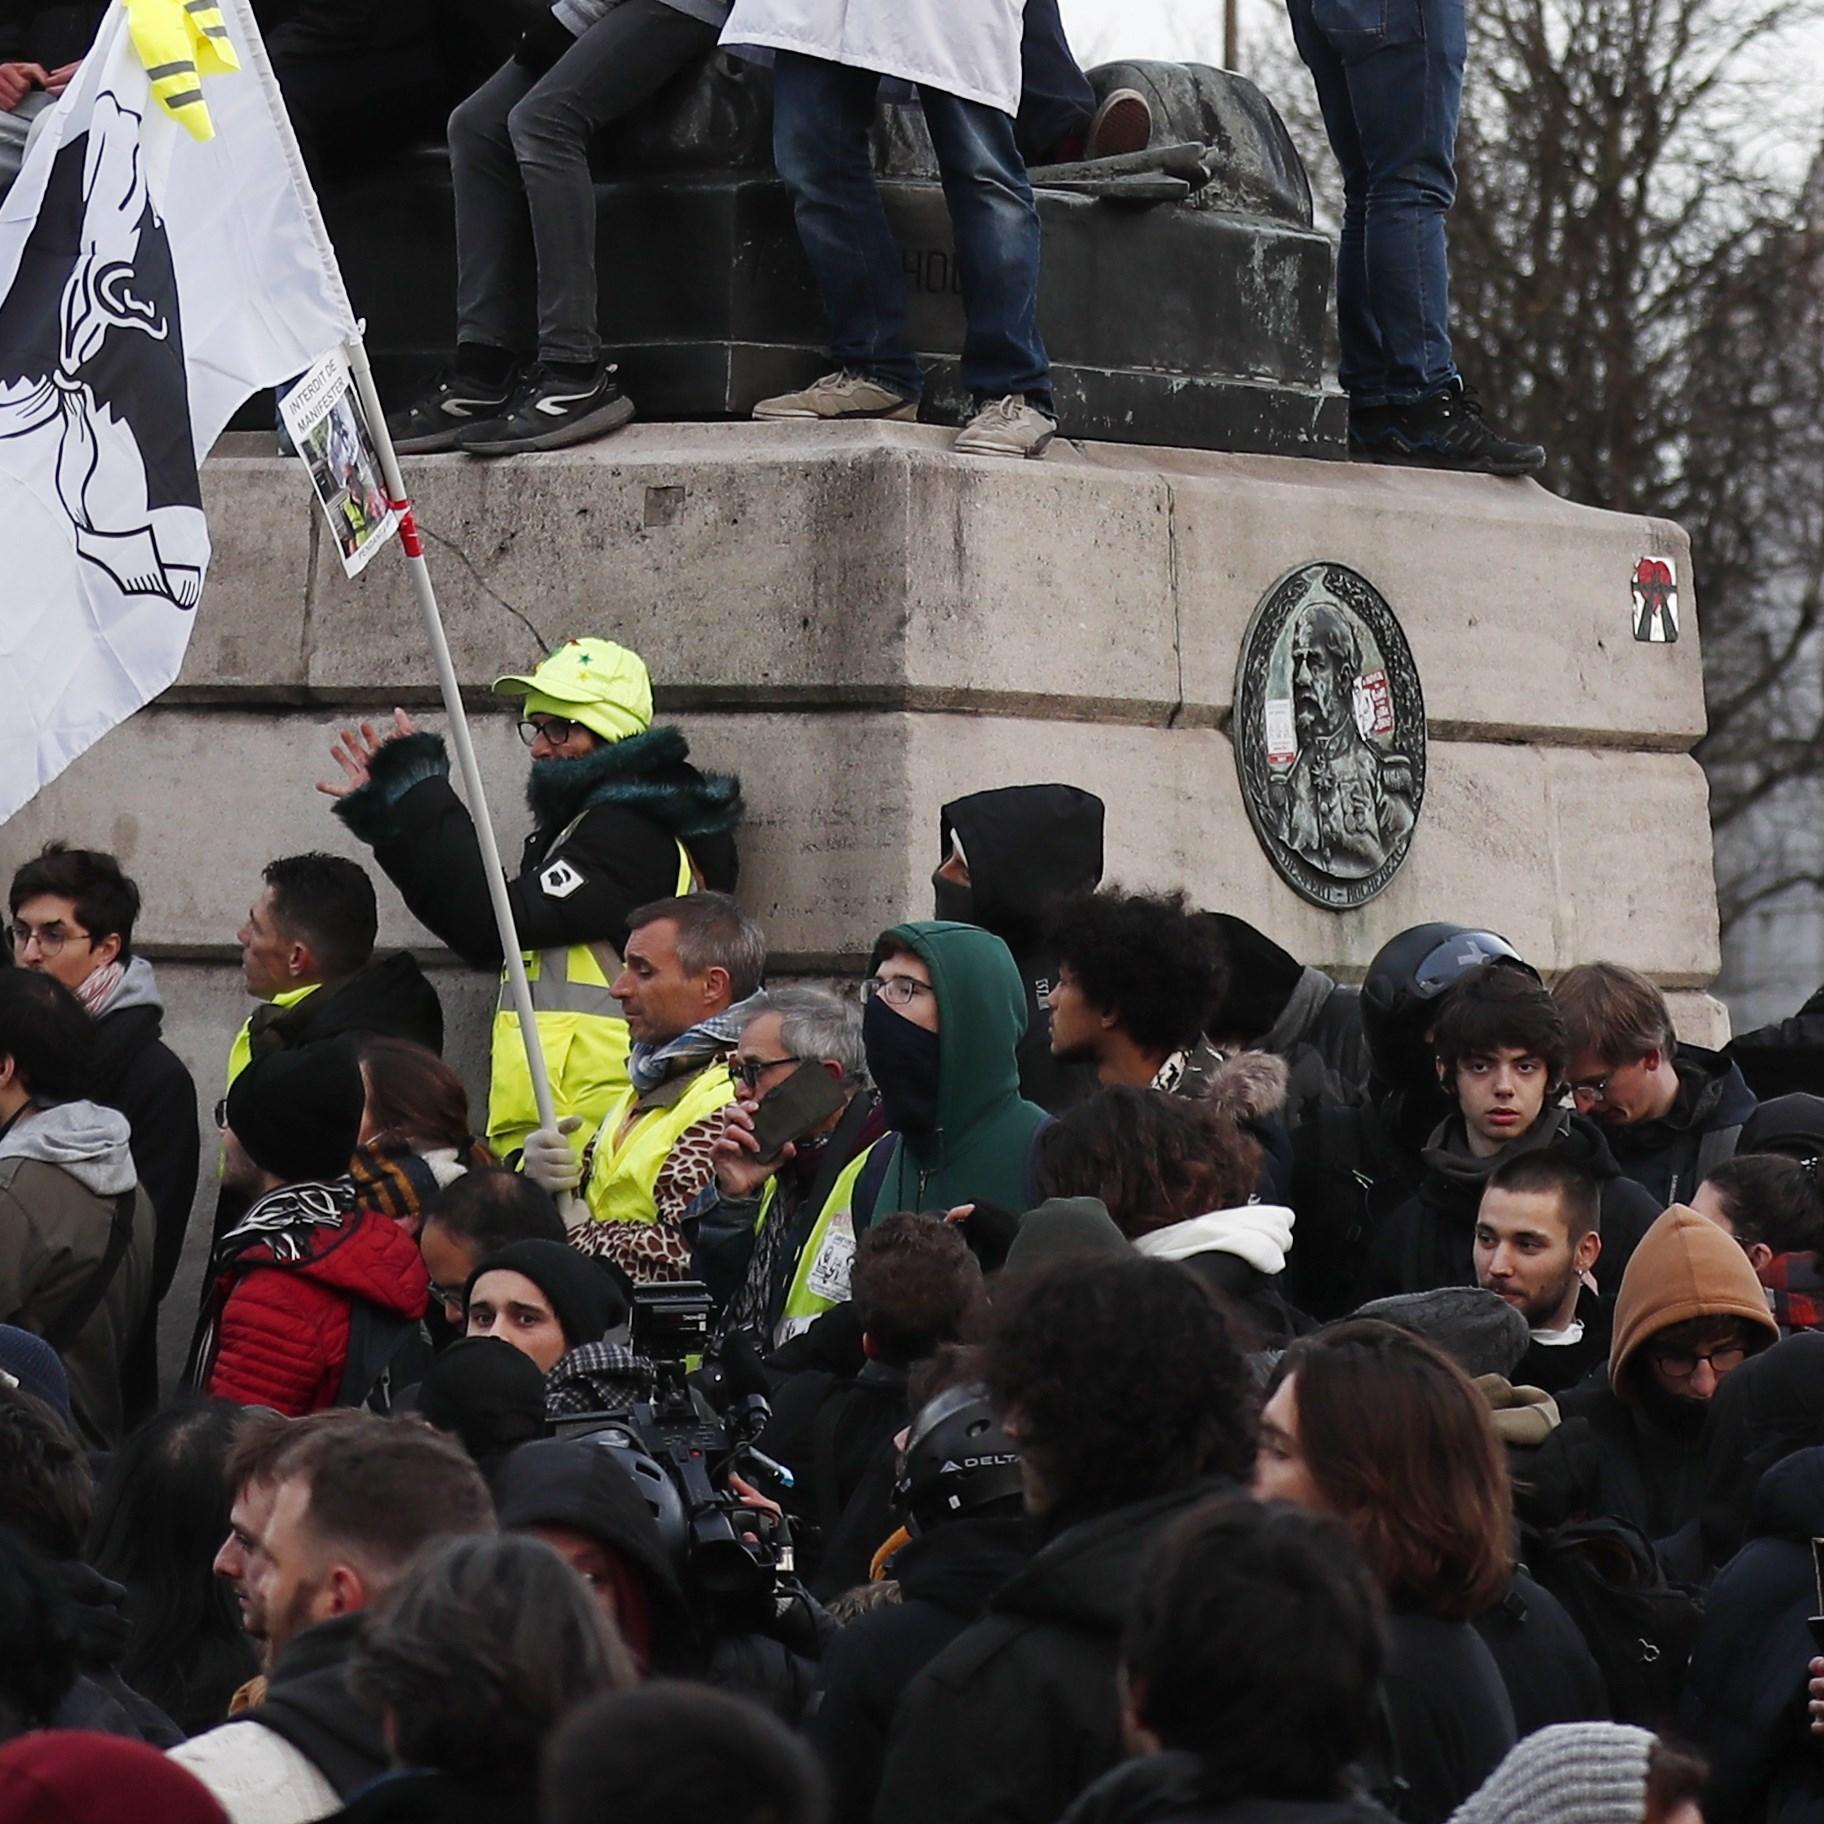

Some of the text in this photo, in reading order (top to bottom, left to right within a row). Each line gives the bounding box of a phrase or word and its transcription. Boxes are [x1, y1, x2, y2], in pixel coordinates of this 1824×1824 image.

[288, 358, 337, 416] INTERDIT DE
[296, 376, 345, 434] MANIFESTER
